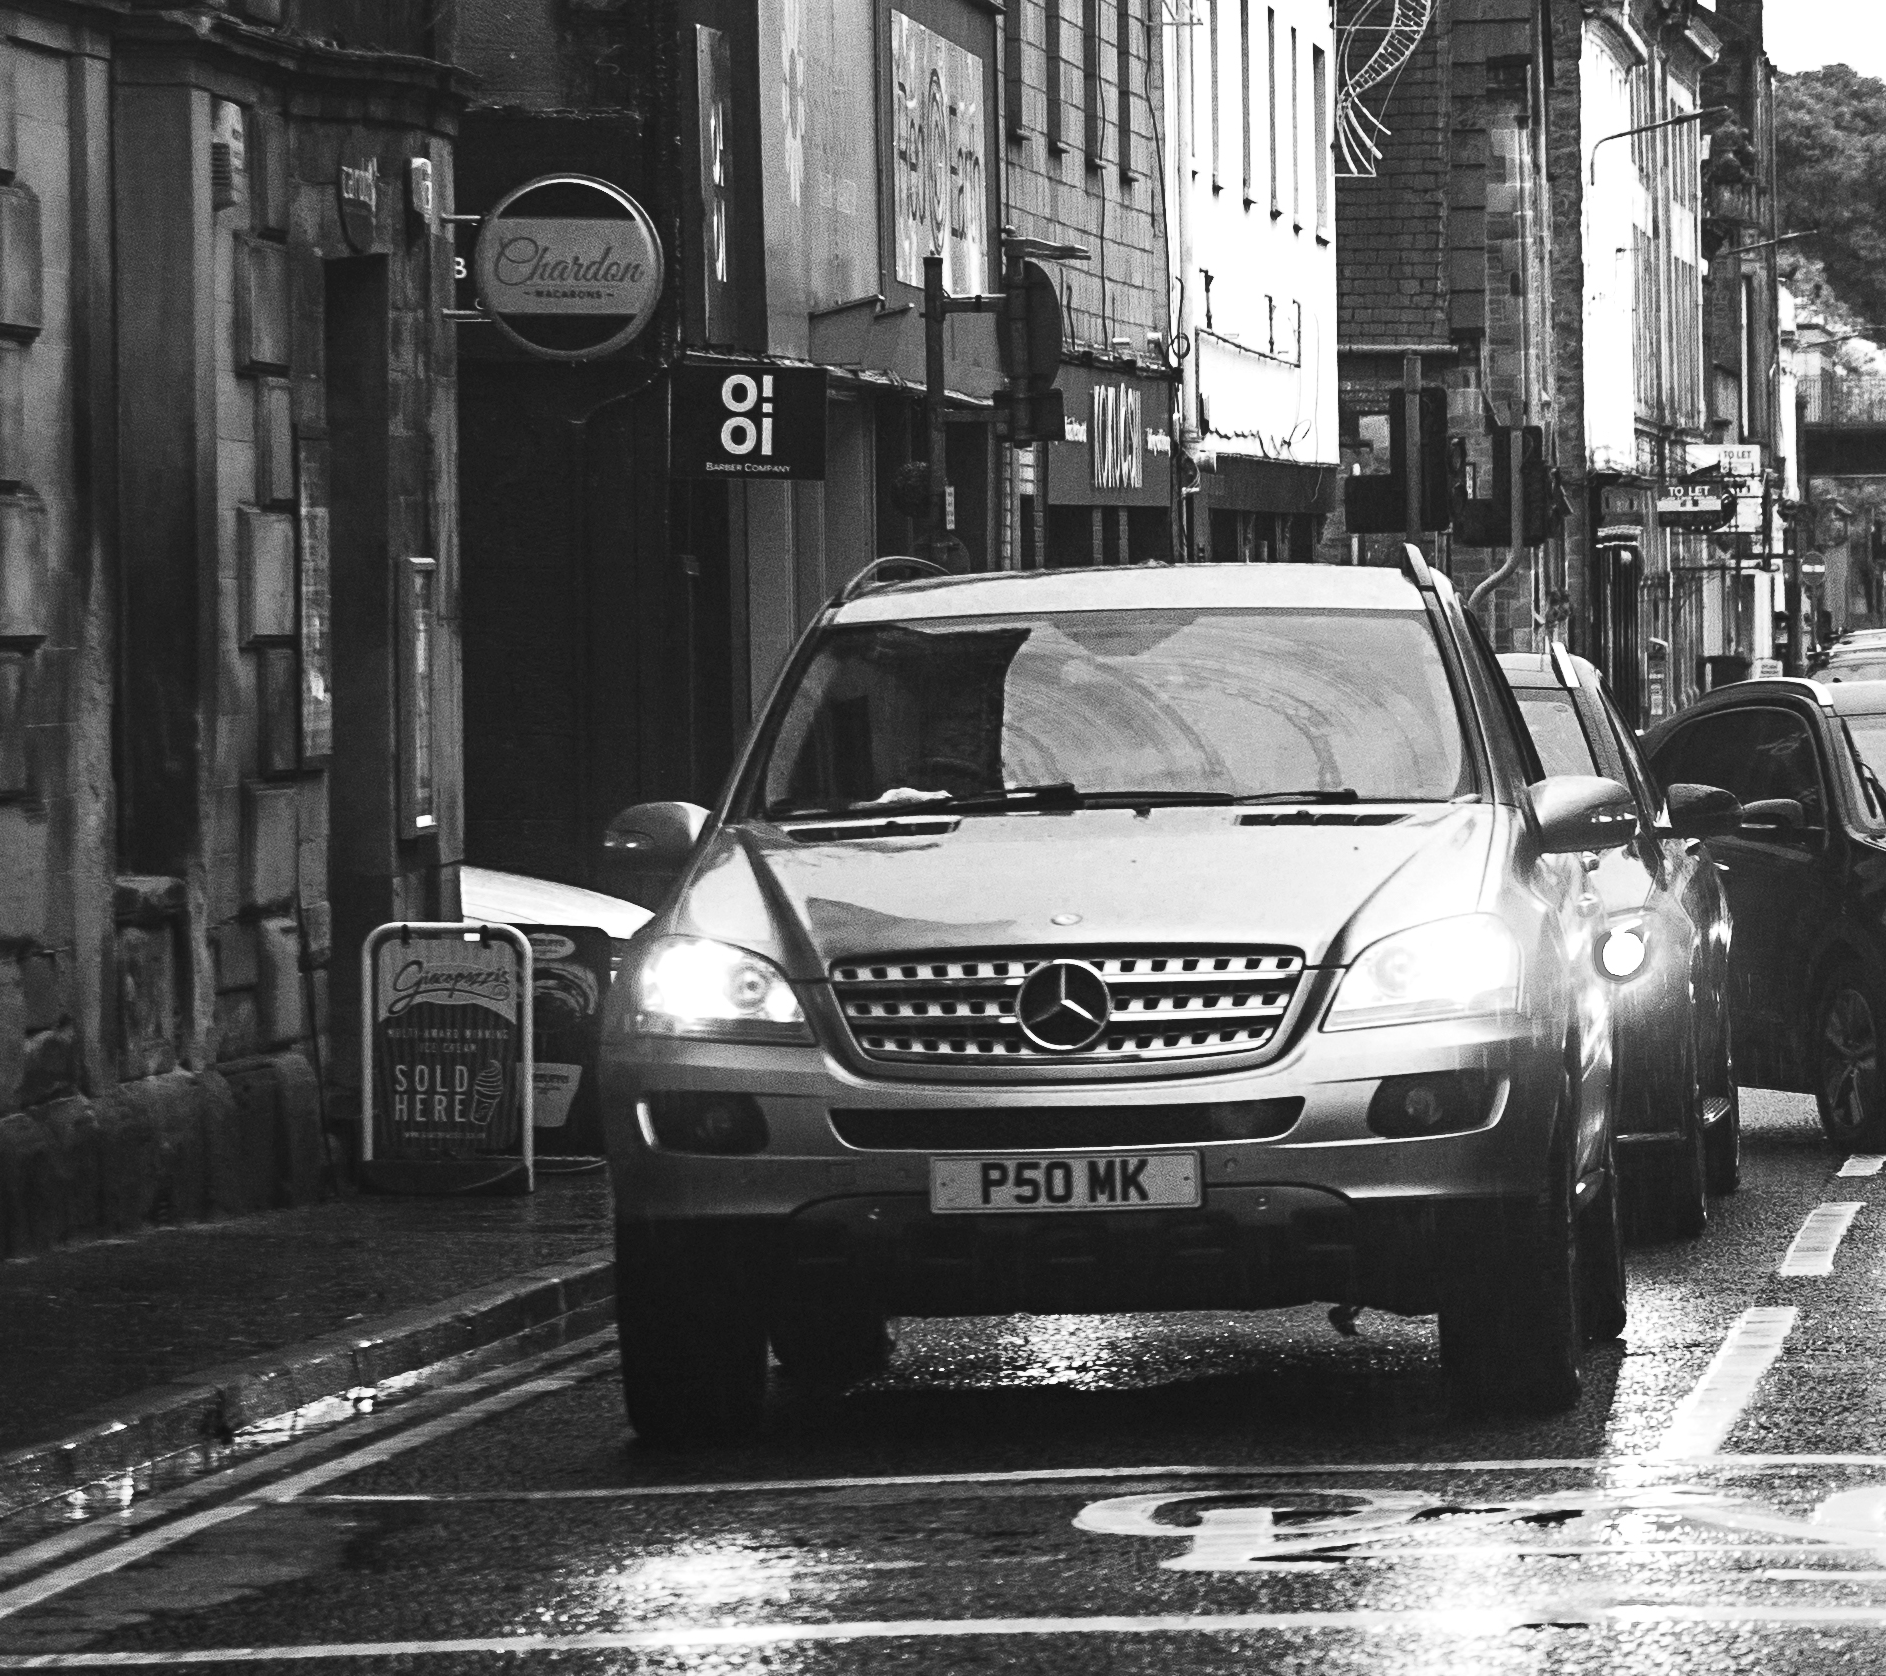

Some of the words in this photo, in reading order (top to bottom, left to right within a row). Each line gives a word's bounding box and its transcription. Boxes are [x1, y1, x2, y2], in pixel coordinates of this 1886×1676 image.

[898, 80, 925, 226] Red
[950, 104, 983, 245] Earth
[494, 236, 645, 287] Chardon
[535, 289, 602, 300] MACARONS
[705, 462, 742, 471] BARBER
[744, 463, 791, 473] COMPANY
[1723, 450, 1734, 459] TO
[1737, 450, 1751, 459] LET
[1668, 486, 1684, 496] TO
[1688, 485, 1710, 496] LET
[394, 1064, 469, 1093] SOLD
[394, 1094, 468, 1122] HERE
[981, 1160, 1074, 1205] P50
[1087, 1157, 1149, 1203] MK
